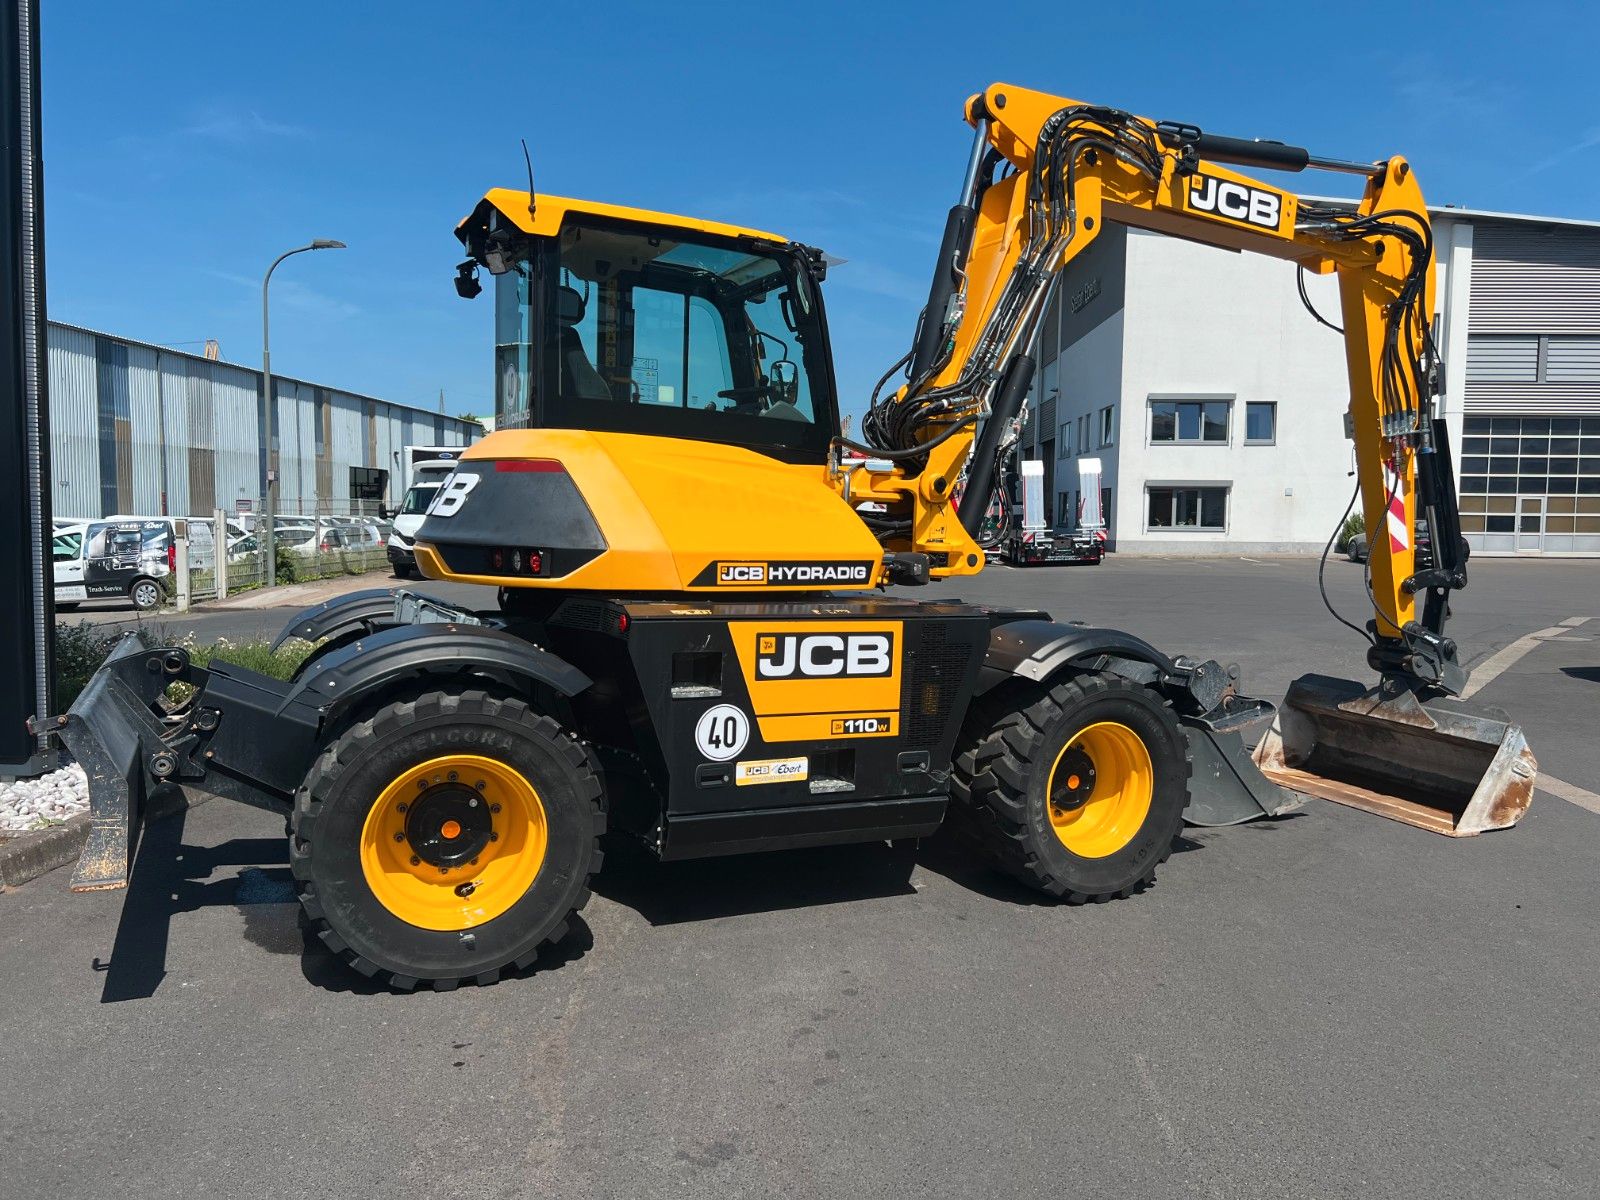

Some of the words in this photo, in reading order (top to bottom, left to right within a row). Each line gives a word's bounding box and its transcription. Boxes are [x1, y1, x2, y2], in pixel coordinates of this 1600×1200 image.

[1191, 178, 1279, 227] JCB
[721, 567, 764, 580] JCB
[768, 566, 866, 580] HYDRADIG
[759, 635, 890, 677] JCB
[708, 716, 737, 749] 40
[747, 767, 769, 775] JCB
[777, 764, 801, 774] Ebert
